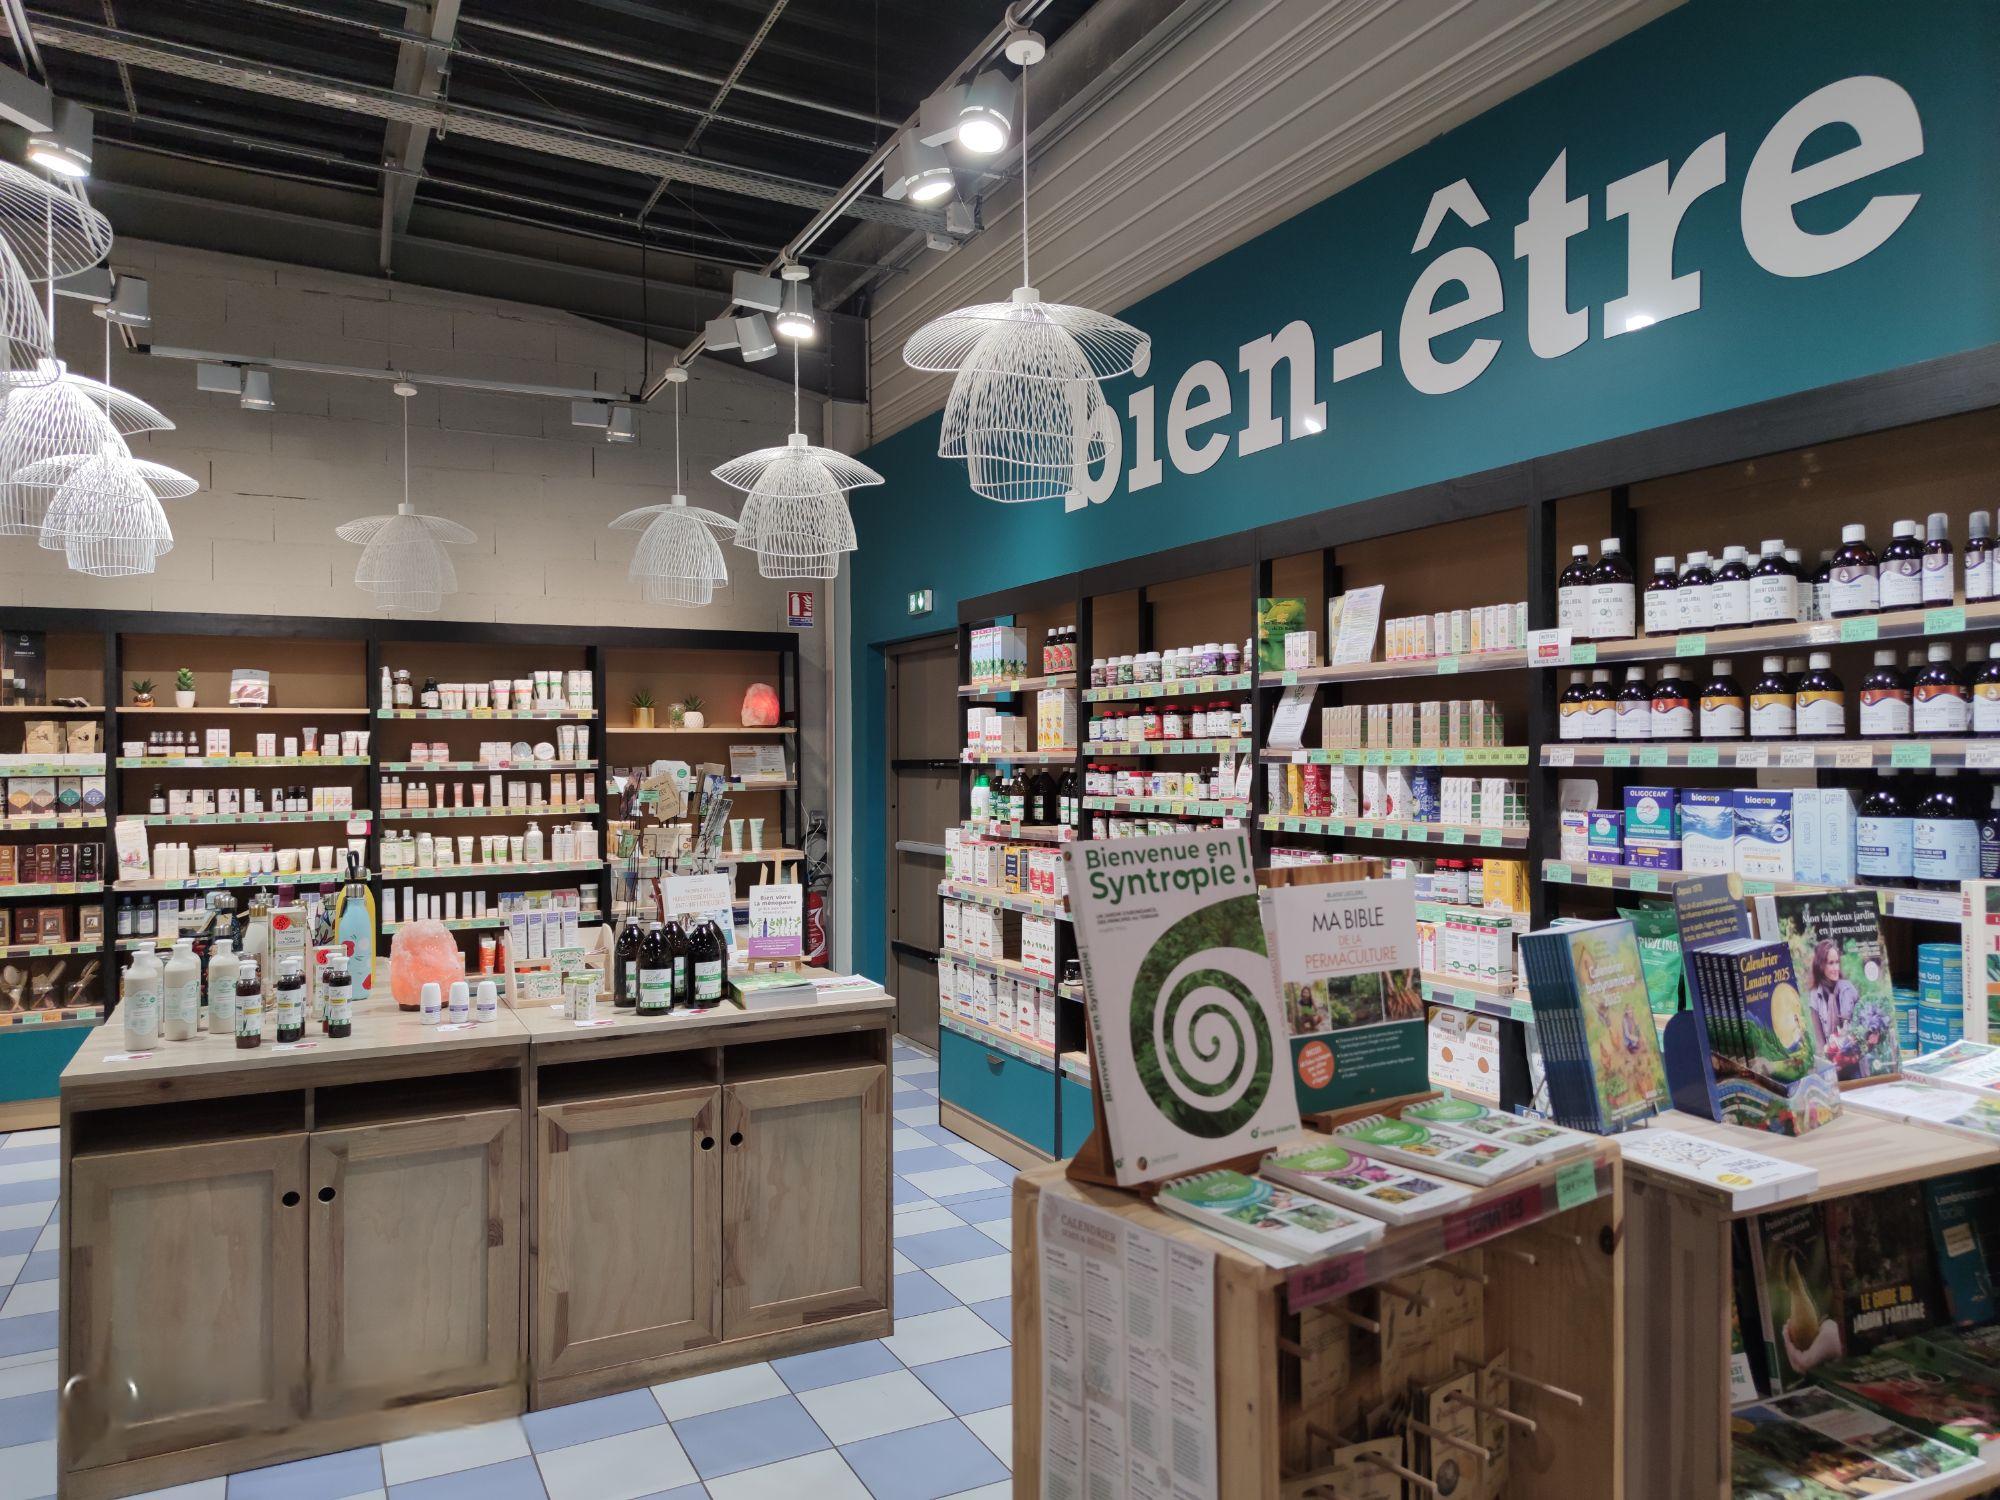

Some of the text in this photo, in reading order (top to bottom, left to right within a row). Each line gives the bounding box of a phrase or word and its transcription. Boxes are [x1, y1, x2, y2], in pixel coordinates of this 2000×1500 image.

[1064, 76, 1924, 513] bien-être
[1085, 841, 1231, 870] Bienvenue en
[1089, 857, 1236, 905] Syntropie
[1312, 907, 1384, 932] MA BIBLE
[1802, 910, 1875, 923] Mon fabuleux jardin
[1339, 934, 1362, 946] DE LA
[1829, 923, 1877, 937] permaculture
[1305, 945, 1398, 969] PERMACULTURE
[1740, 952, 1779, 973] Calendrier
[1082, 951, 1100, 1012] Syntropie
[1743, 968, 1790, 991] Lunaire 2025
[1927, 972, 1941, 981] bio
[1932, 1032, 1947, 1041] bio
[1096, 1034, 1113, 1102] Bienvenue
[1061, 1214, 1116, 1244] CALENDRIER
[1860, 1293, 1870, 1311] LE
